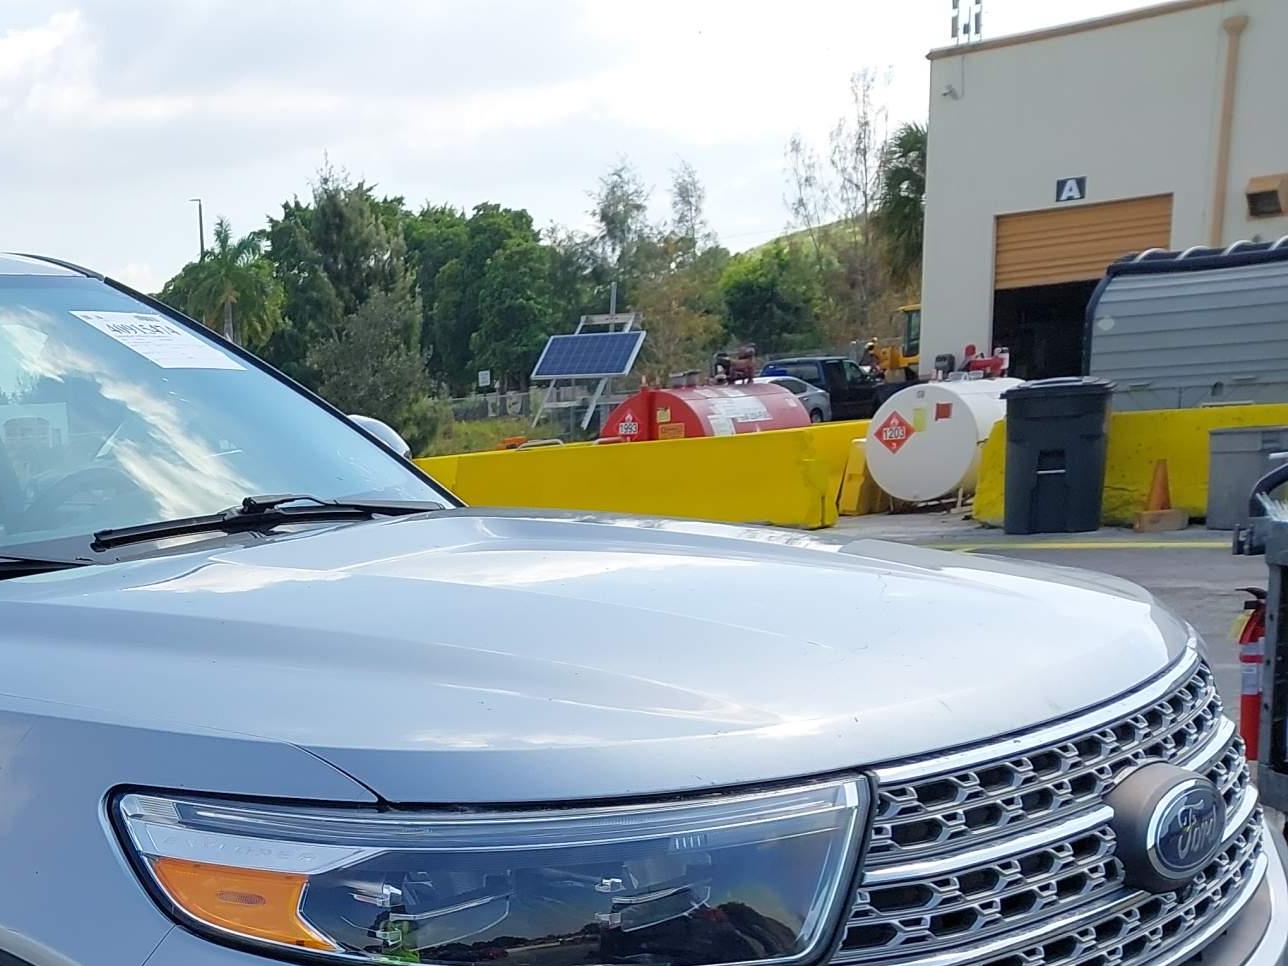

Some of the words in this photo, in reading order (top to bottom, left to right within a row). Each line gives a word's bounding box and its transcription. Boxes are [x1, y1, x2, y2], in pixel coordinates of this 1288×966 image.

[1059, 179, 1081, 200] A
[620, 423, 638, 434] 1993
[883, 427, 906, 440] 1203
[1176, 799, 1217, 860] Ford
